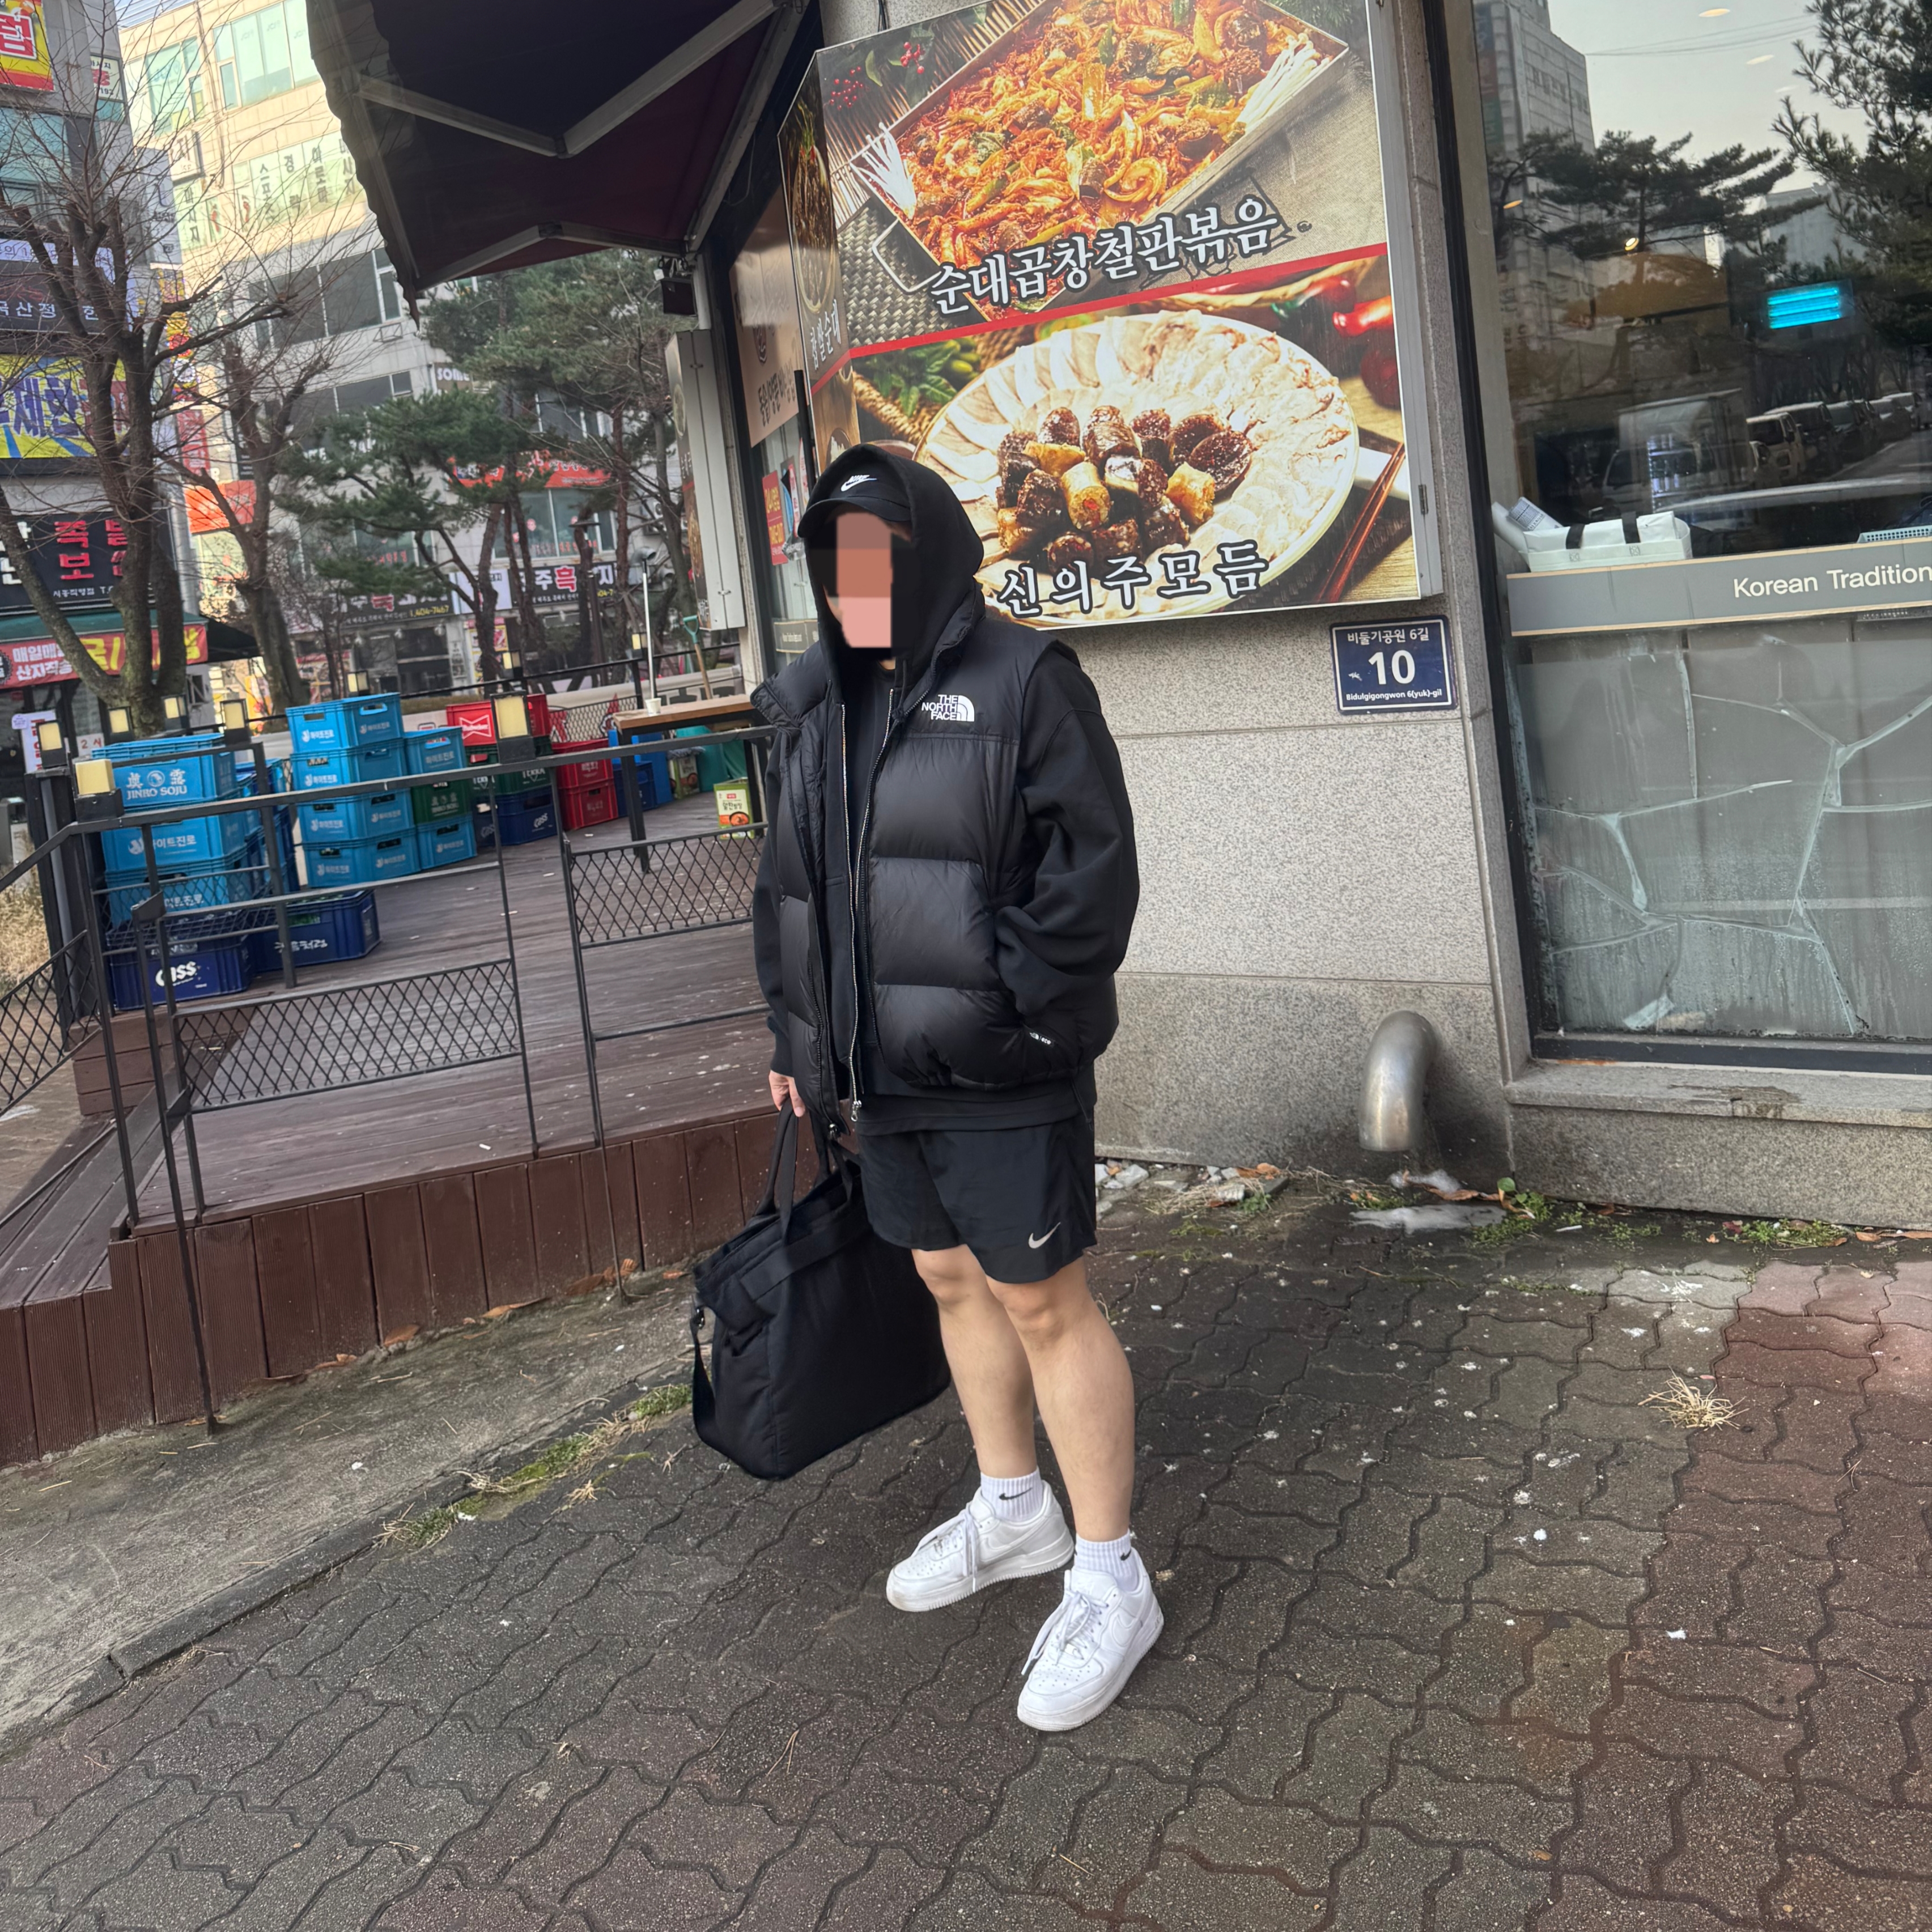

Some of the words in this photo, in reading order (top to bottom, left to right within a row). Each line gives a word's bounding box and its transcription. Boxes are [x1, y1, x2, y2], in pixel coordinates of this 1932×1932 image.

[930, 197, 1277, 315] 순대곱창철판볶음
[810, 298, 842, 371] 찹쌀순대
[999, 542, 1267, 616] 신의주모듬
[1734, 578, 1818, 598] Korean
[1348, 629, 1406, 645] 비둘기공원
[1409, 627, 1429, 641] 6길
[16, 660, 72, 681] 산지직송
[1368, 649, 1416, 685] 10
[937, 694, 958, 703] THE
[1346, 691, 1406, 702] Bidulgigongwon
[1407, 689, 1442, 699] 6(yuk)-gil
[921, 702, 957, 712] NORTH
[931, 711, 957, 720] FACE
[126, 788, 158, 800] JINRO
[160, 785, 188, 796] SOJU
